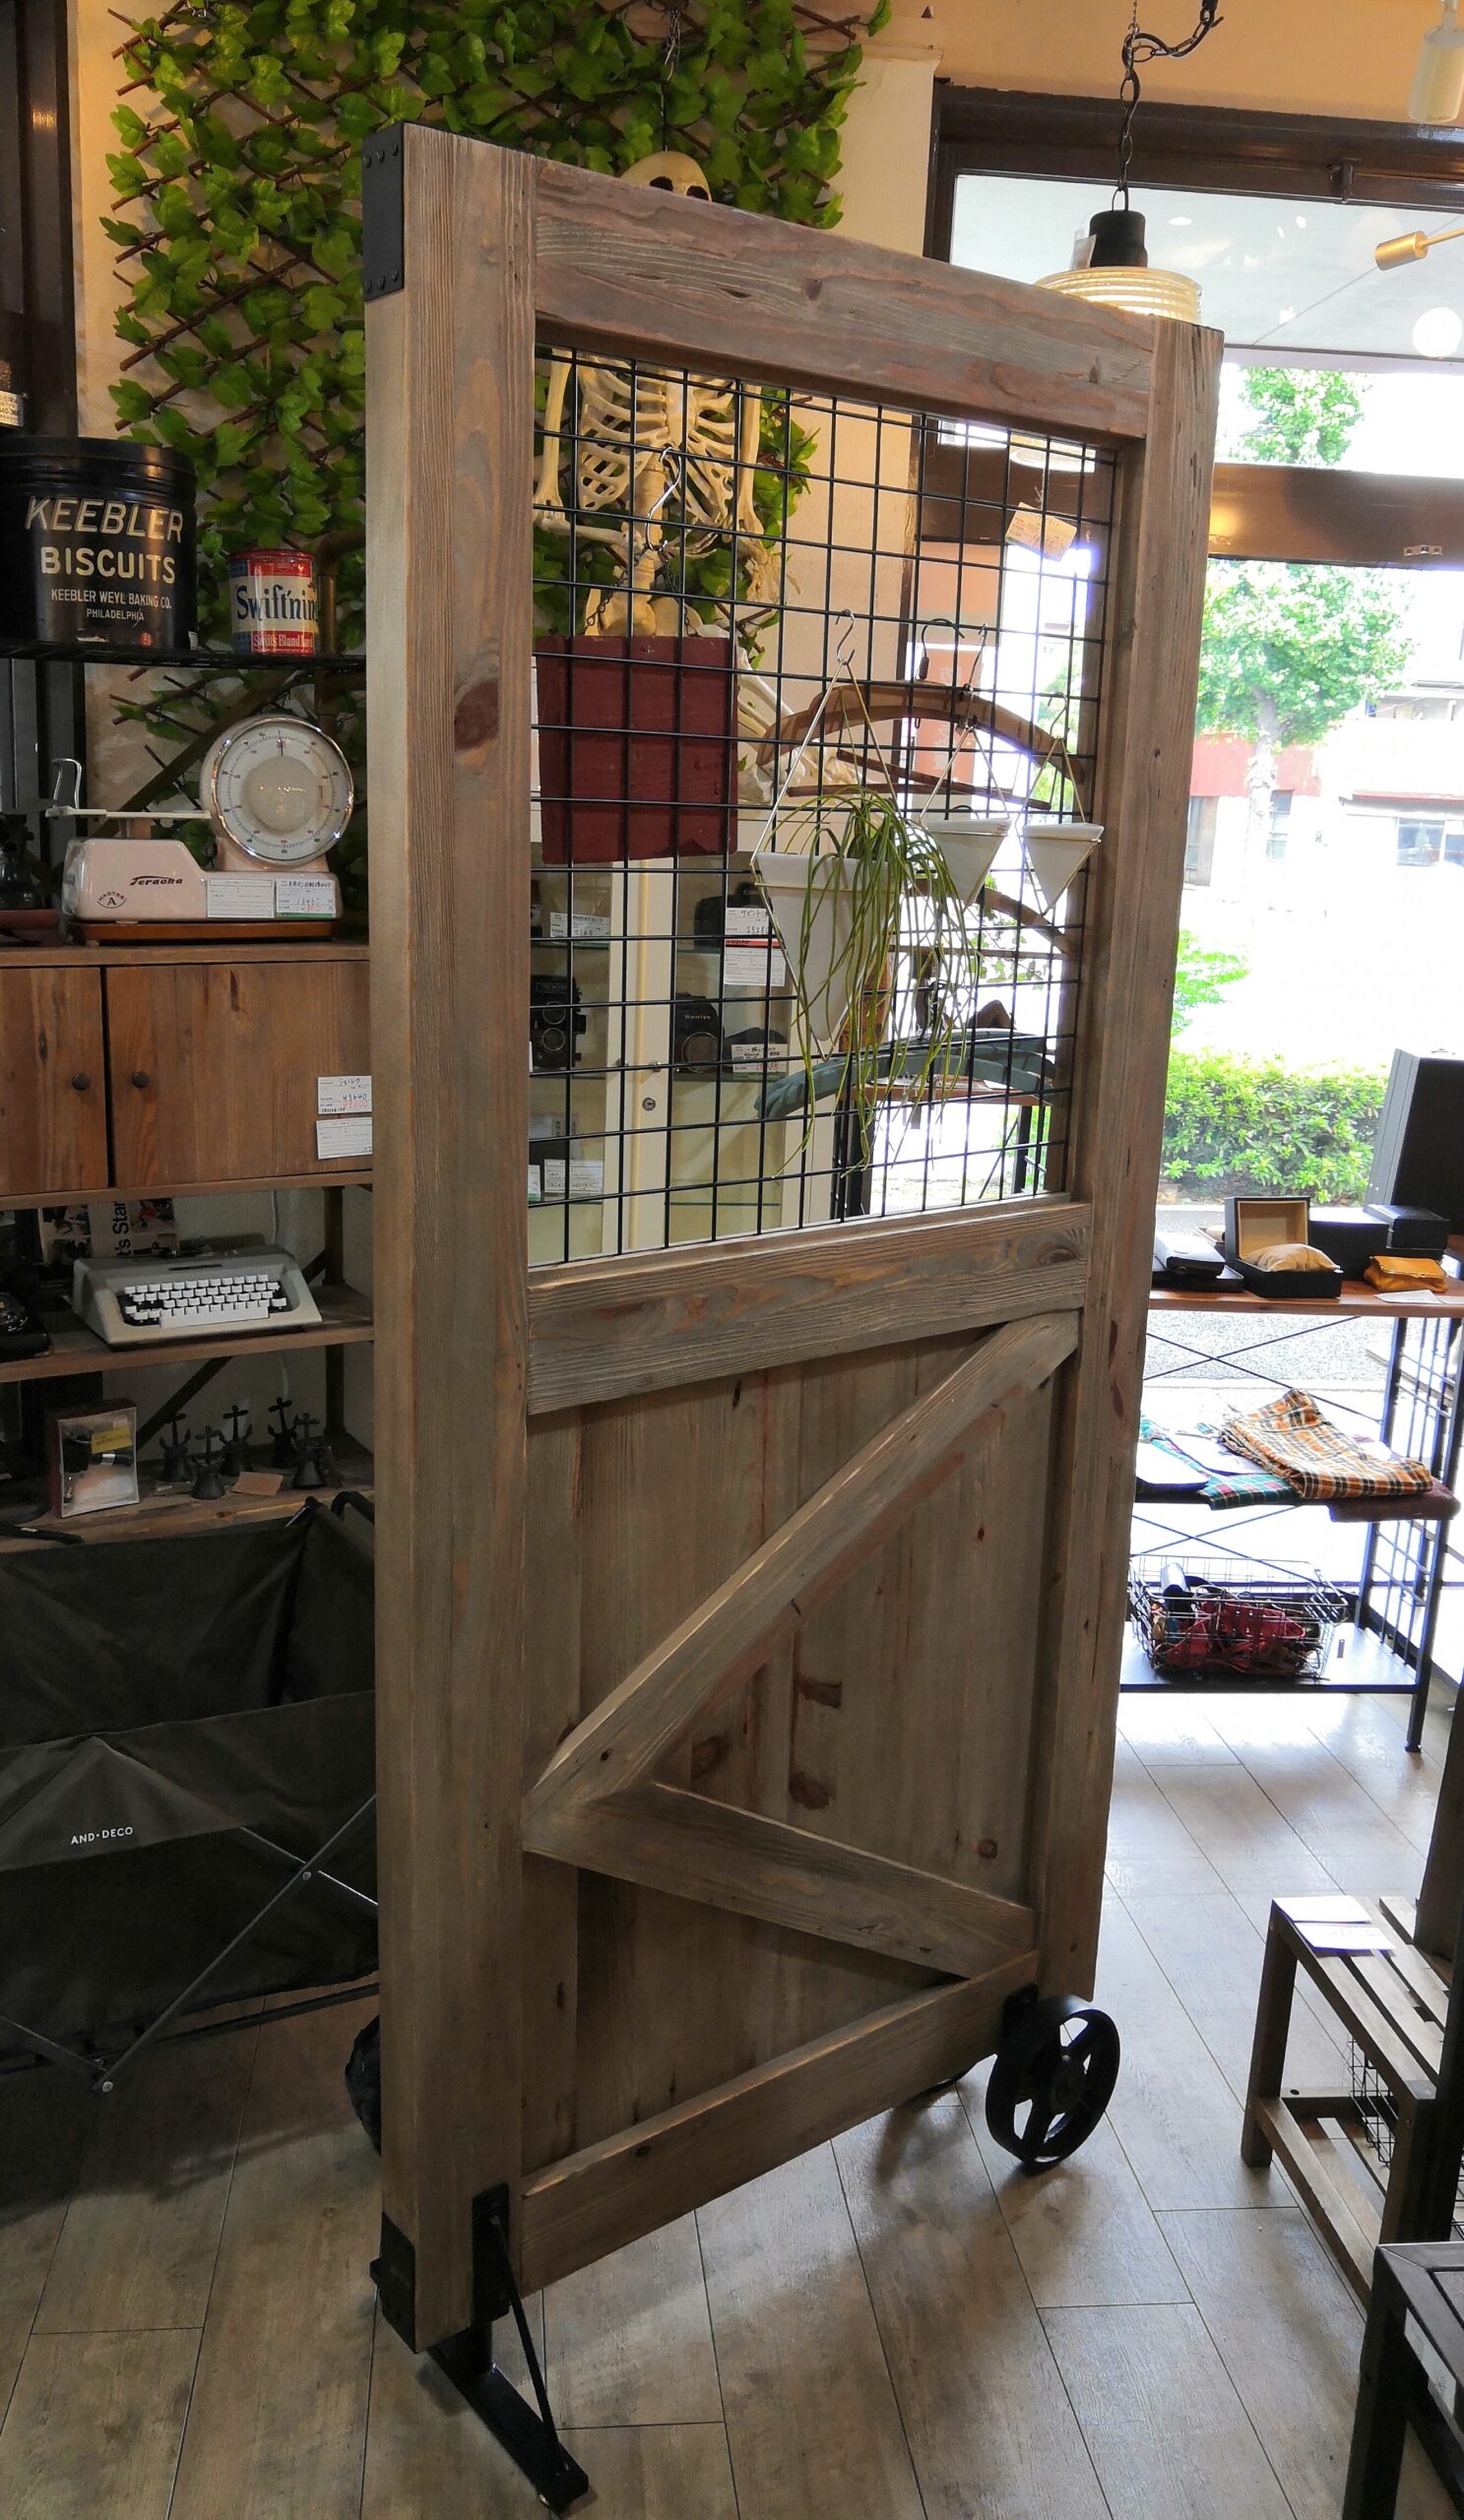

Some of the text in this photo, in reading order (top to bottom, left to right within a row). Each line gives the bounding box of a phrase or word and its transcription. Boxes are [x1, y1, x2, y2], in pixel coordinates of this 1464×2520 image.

[25, 495, 183, 543] KEEBLER
[40, 546, 175, 585] BISCUITS
[51, 589, 172, 609] KEEBLER WEYL BAKING CO.
[236, 584, 317, 621] Swift'nin
[87, 608, 145, 622] PHILADELPHIA
[107, 897, 117, 906] A
